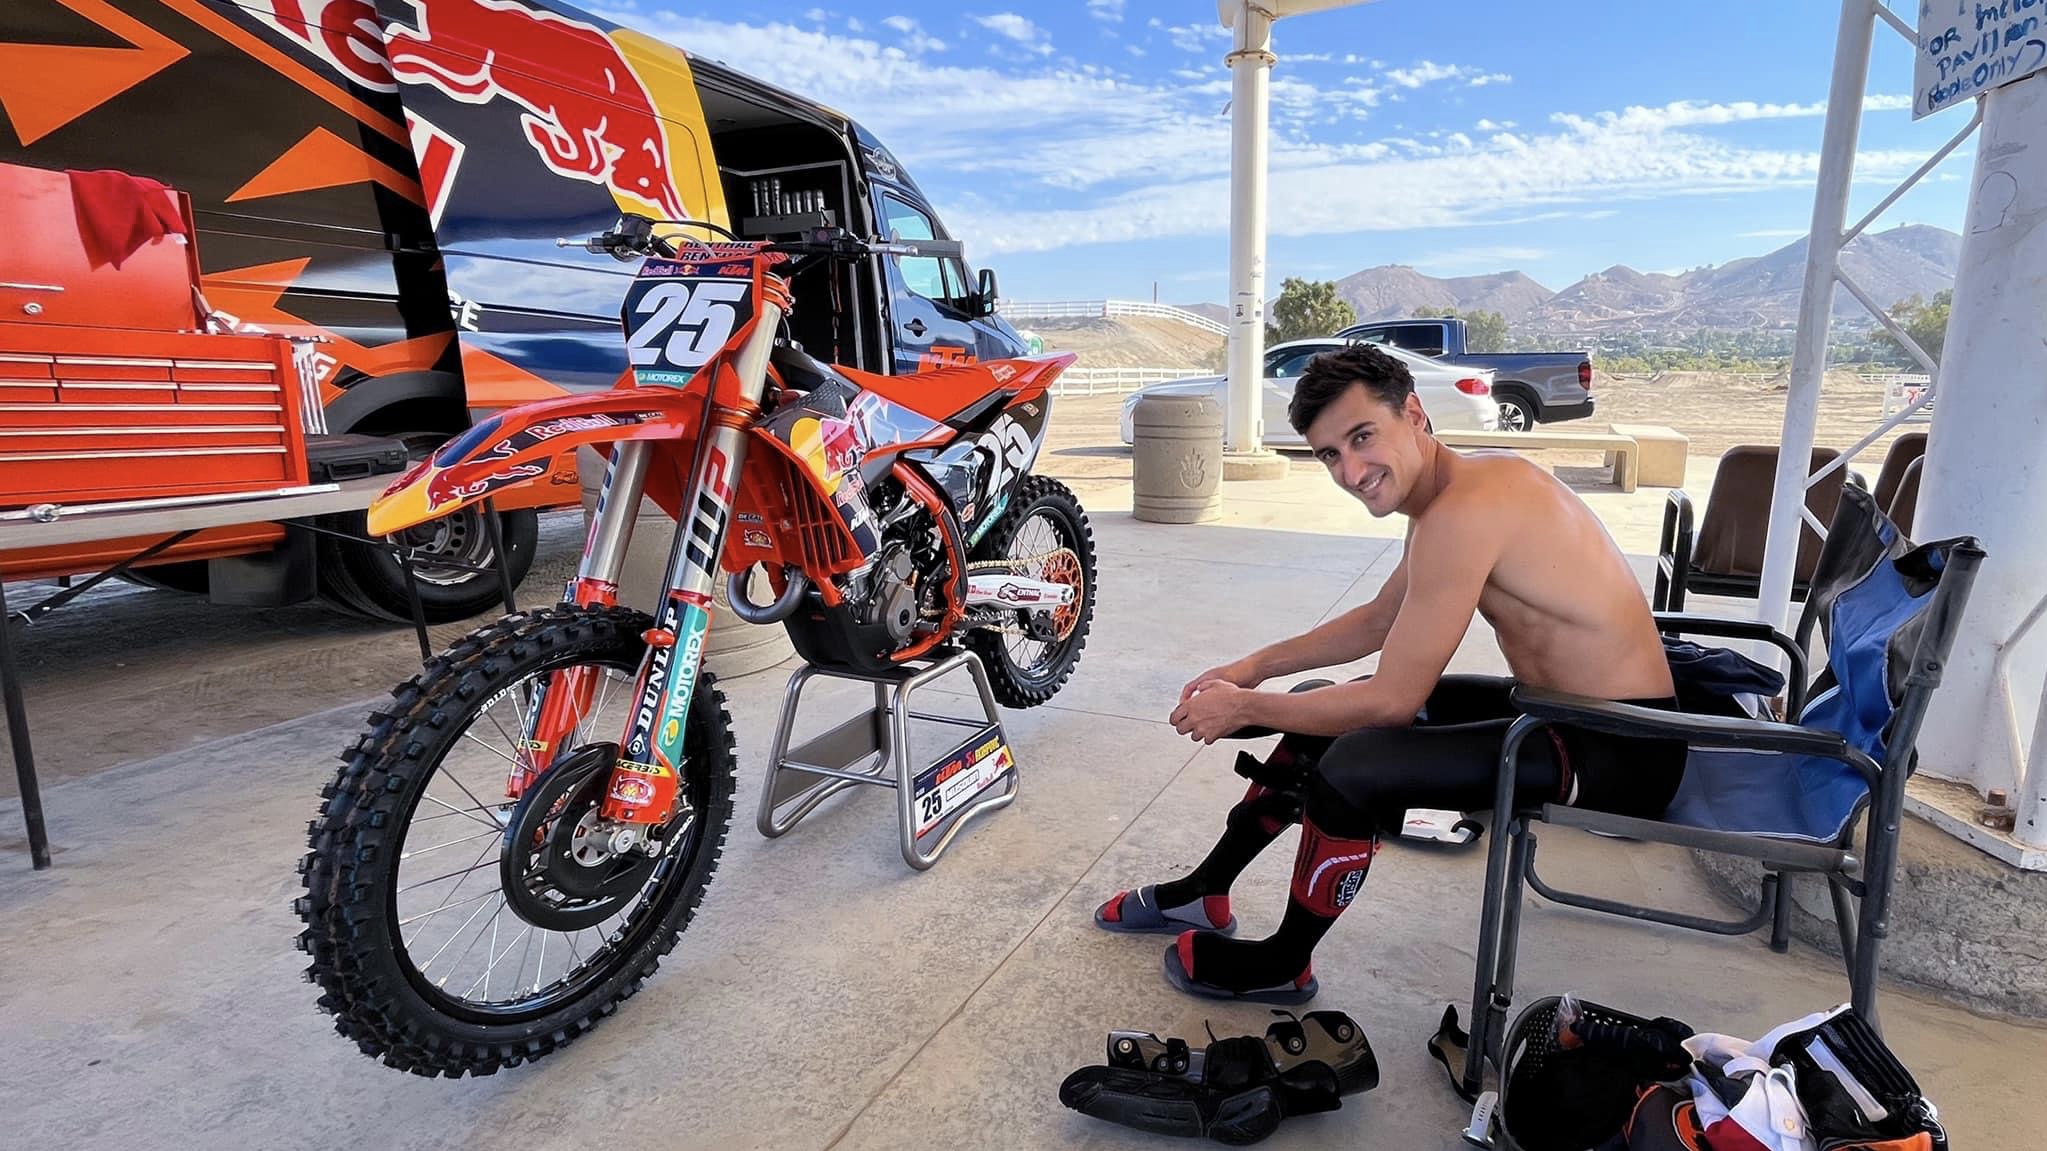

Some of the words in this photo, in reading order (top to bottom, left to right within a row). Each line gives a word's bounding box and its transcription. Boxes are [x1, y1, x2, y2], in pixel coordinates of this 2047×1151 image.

[626, 282, 748, 367] 25
[646, 373, 685, 384] MOTOREX
[976, 413, 1033, 498] 25
[637, 607, 680, 732] DUNLP
[670, 628, 706, 719] MOTOREX
[922, 789, 942, 823] 25
